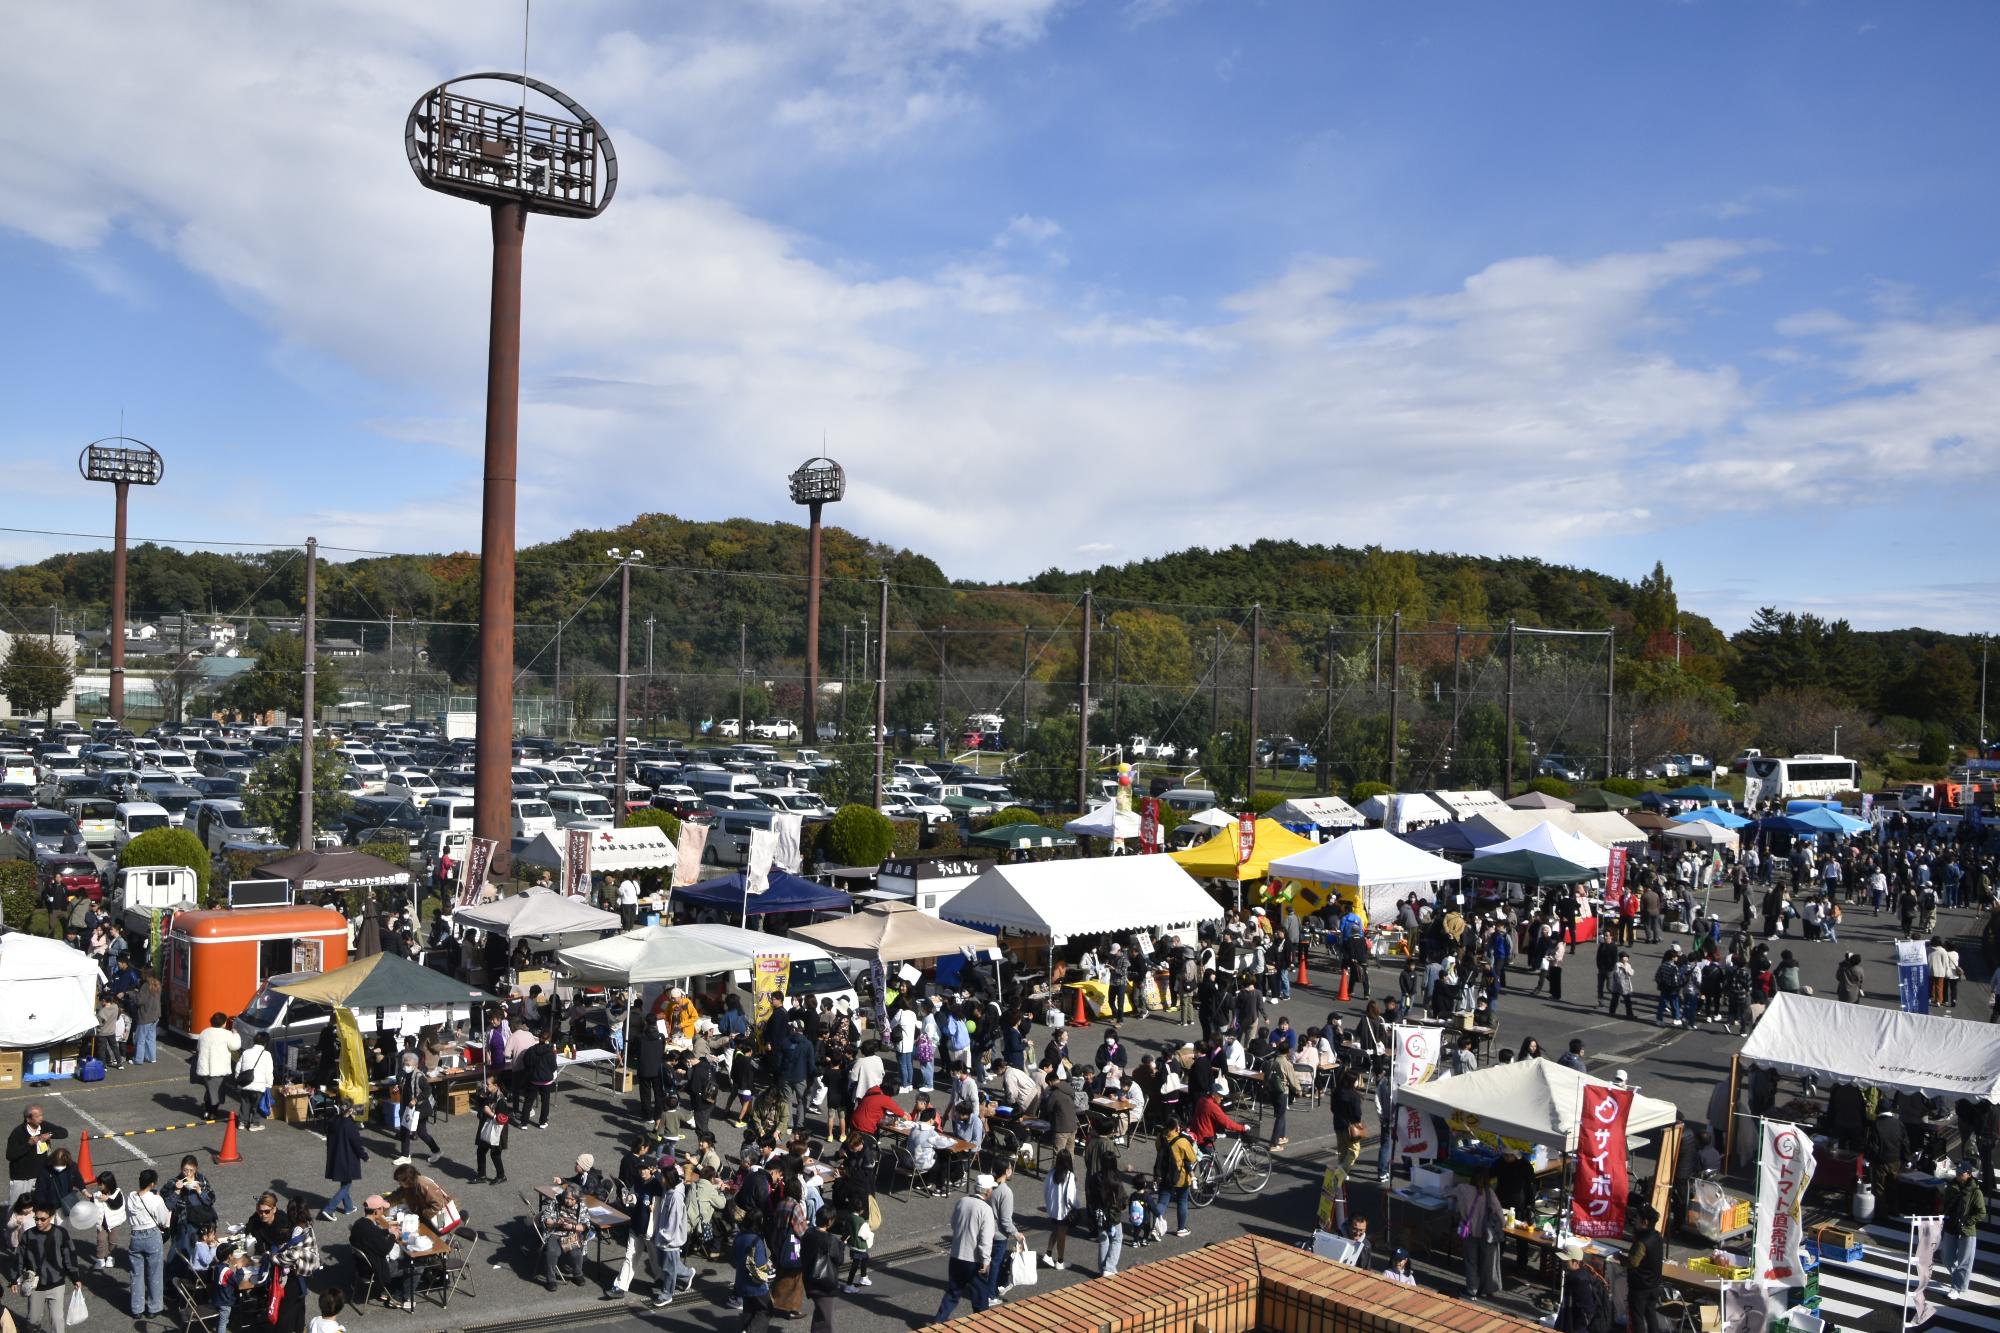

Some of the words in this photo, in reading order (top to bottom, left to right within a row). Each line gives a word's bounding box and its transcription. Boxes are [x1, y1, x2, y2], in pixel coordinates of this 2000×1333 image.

[1588, 1128, 1611, 1217] サイボク
[1768, 1164, 1794, 1262] トマト直売所
